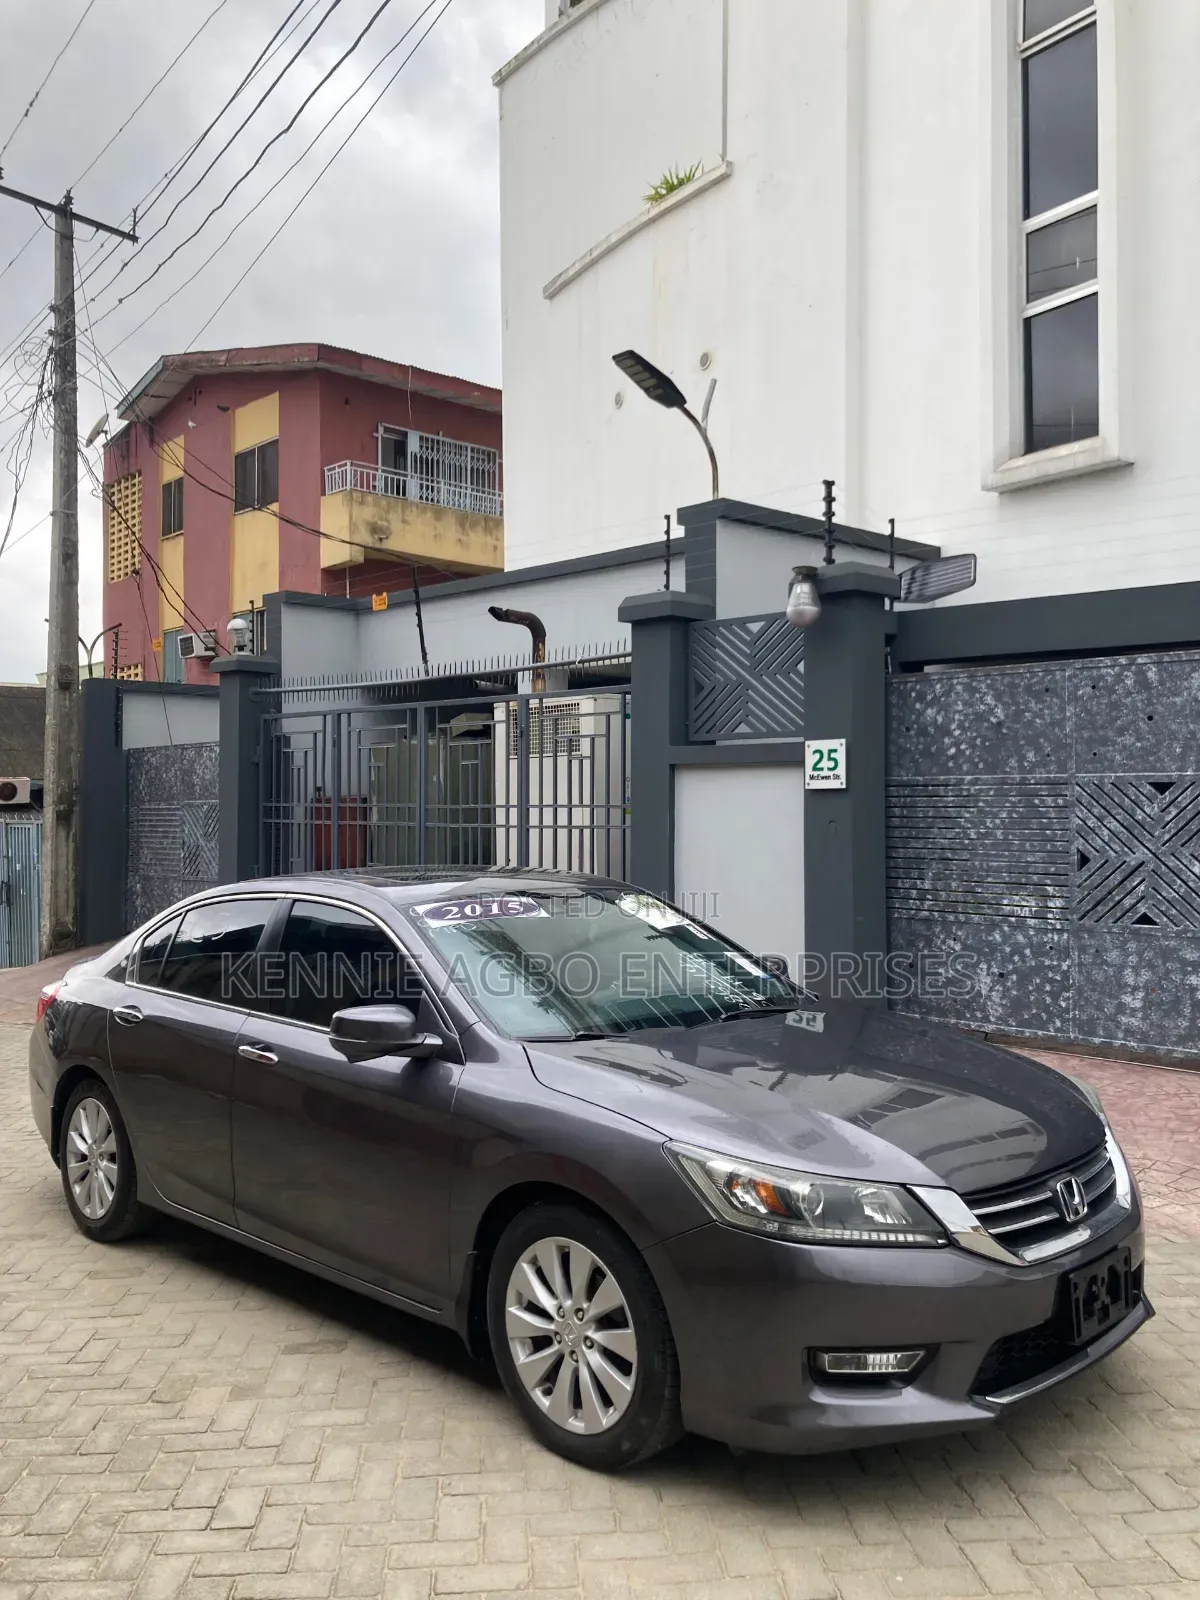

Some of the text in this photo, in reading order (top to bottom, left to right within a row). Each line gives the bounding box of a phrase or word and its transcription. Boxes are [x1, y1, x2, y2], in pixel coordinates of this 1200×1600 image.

[812, 748, 839, 771] 25
[809, 773, 831, 781] McEwen
[441, 899, 524, 920] 2015
